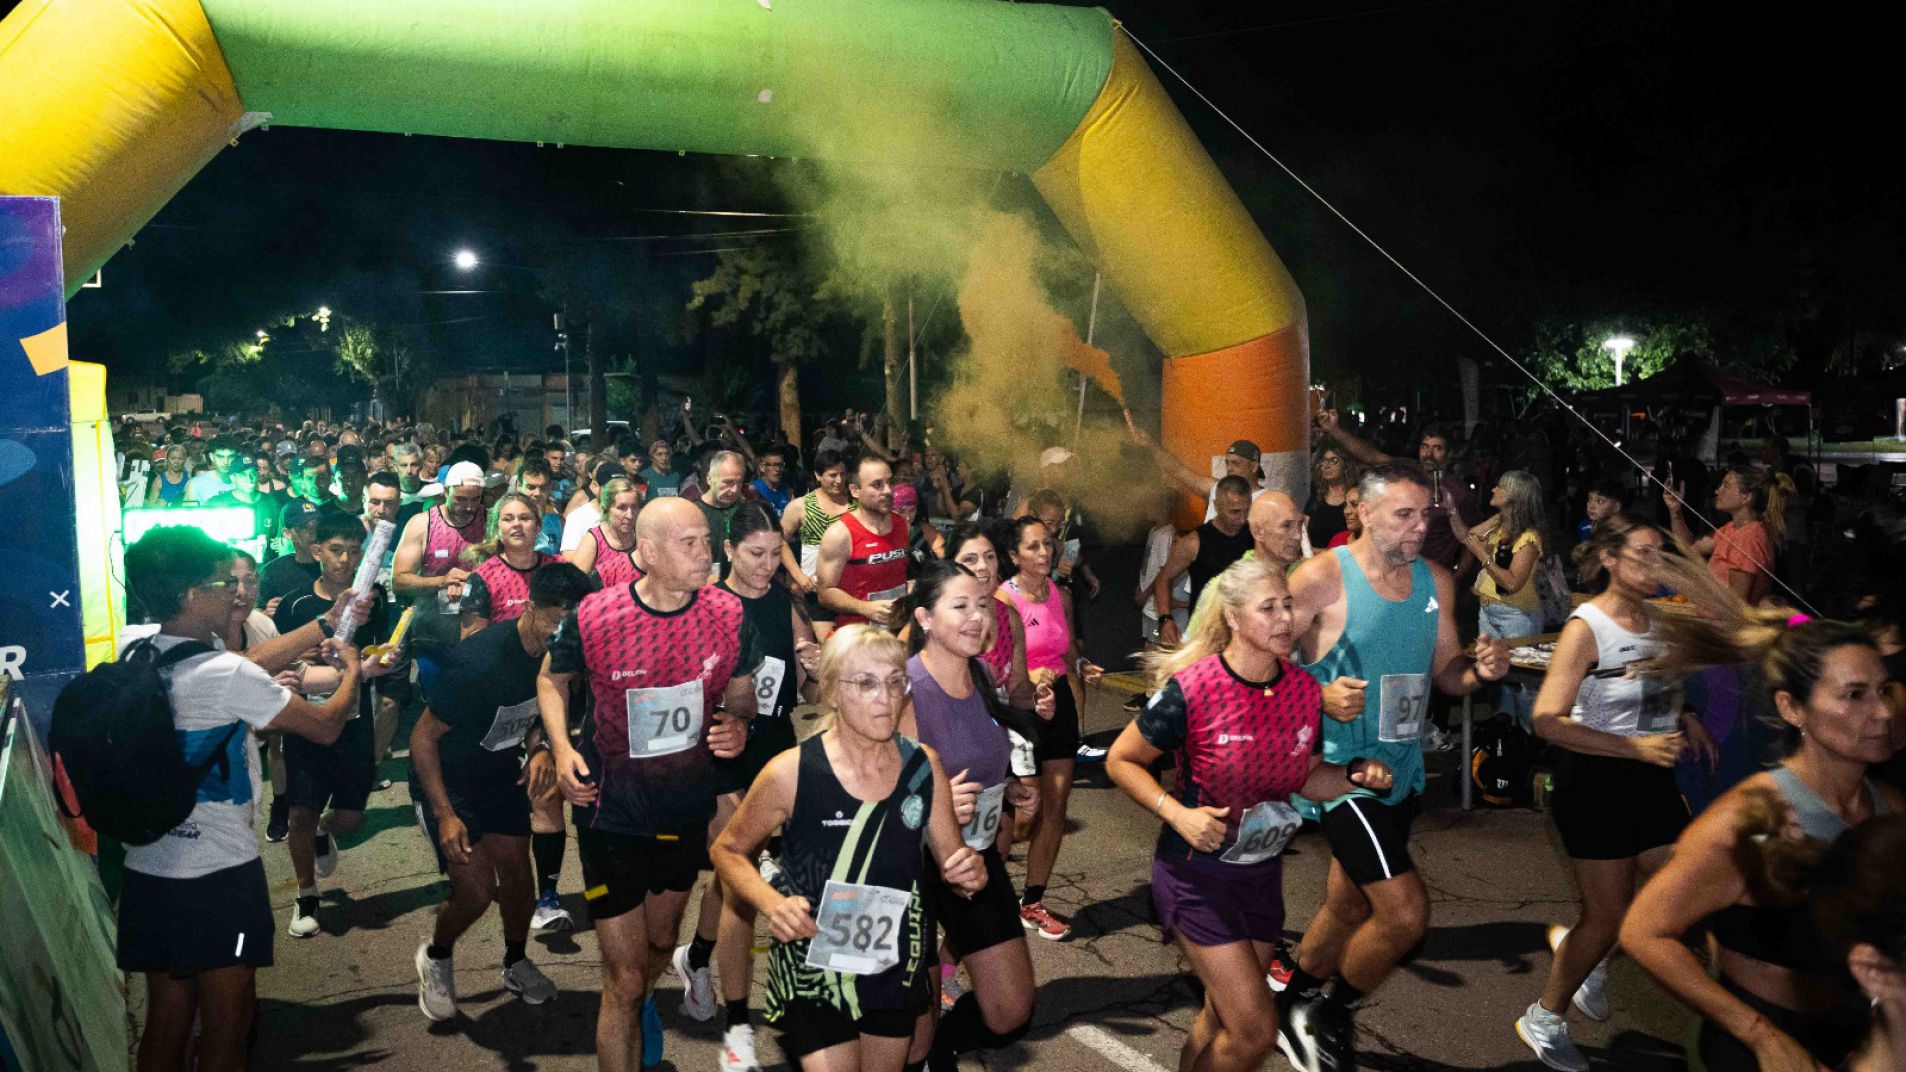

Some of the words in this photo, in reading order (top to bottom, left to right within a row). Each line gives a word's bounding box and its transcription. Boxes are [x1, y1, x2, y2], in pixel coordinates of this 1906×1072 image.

[0, 645, 27, 681] R
[650, 706, 691, 737] 70
[1399, 695, 1424, 723] 97
[1242, 822, 1297, 851] 609
[826, 912, 894, 953] 582
